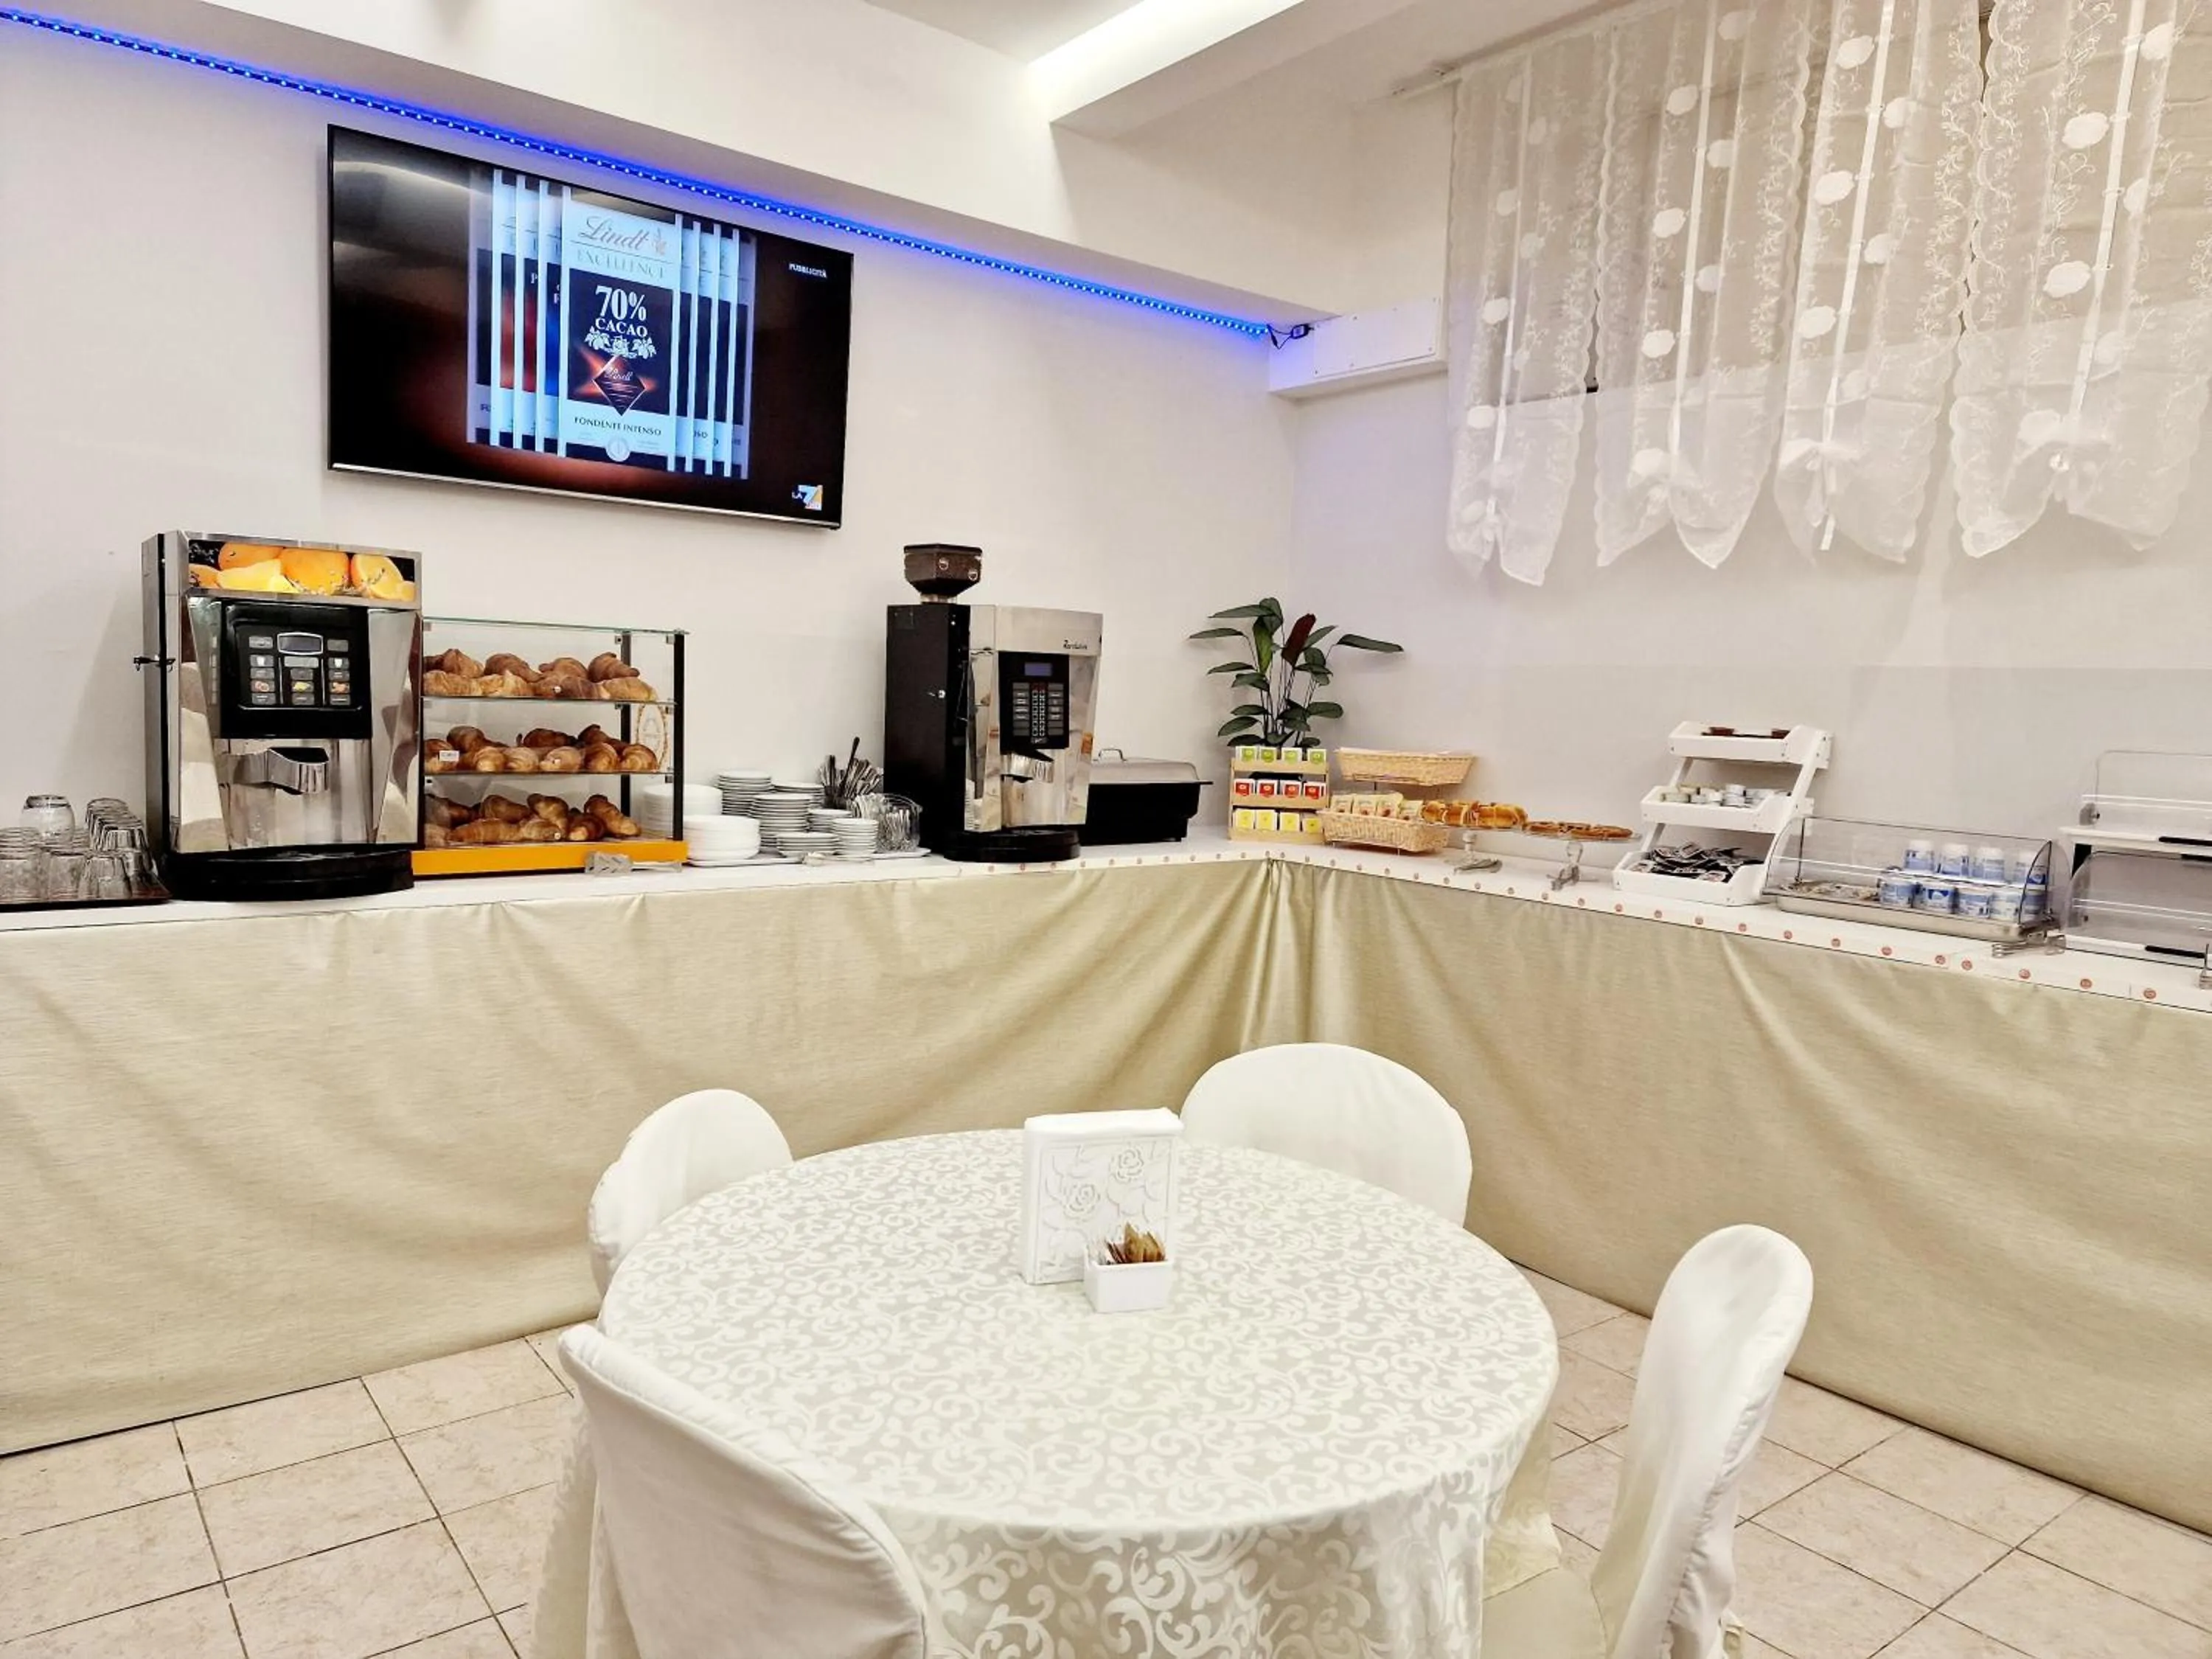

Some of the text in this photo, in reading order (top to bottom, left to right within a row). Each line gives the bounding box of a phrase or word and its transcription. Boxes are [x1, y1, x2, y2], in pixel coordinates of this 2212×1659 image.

[577, 216, 650, 250] Lindt
[595, 285, 647, 321] 70%
[595, 318, 648, 338] CACAO
[574, 417, 661, 437] FONDENTE INTENSO
